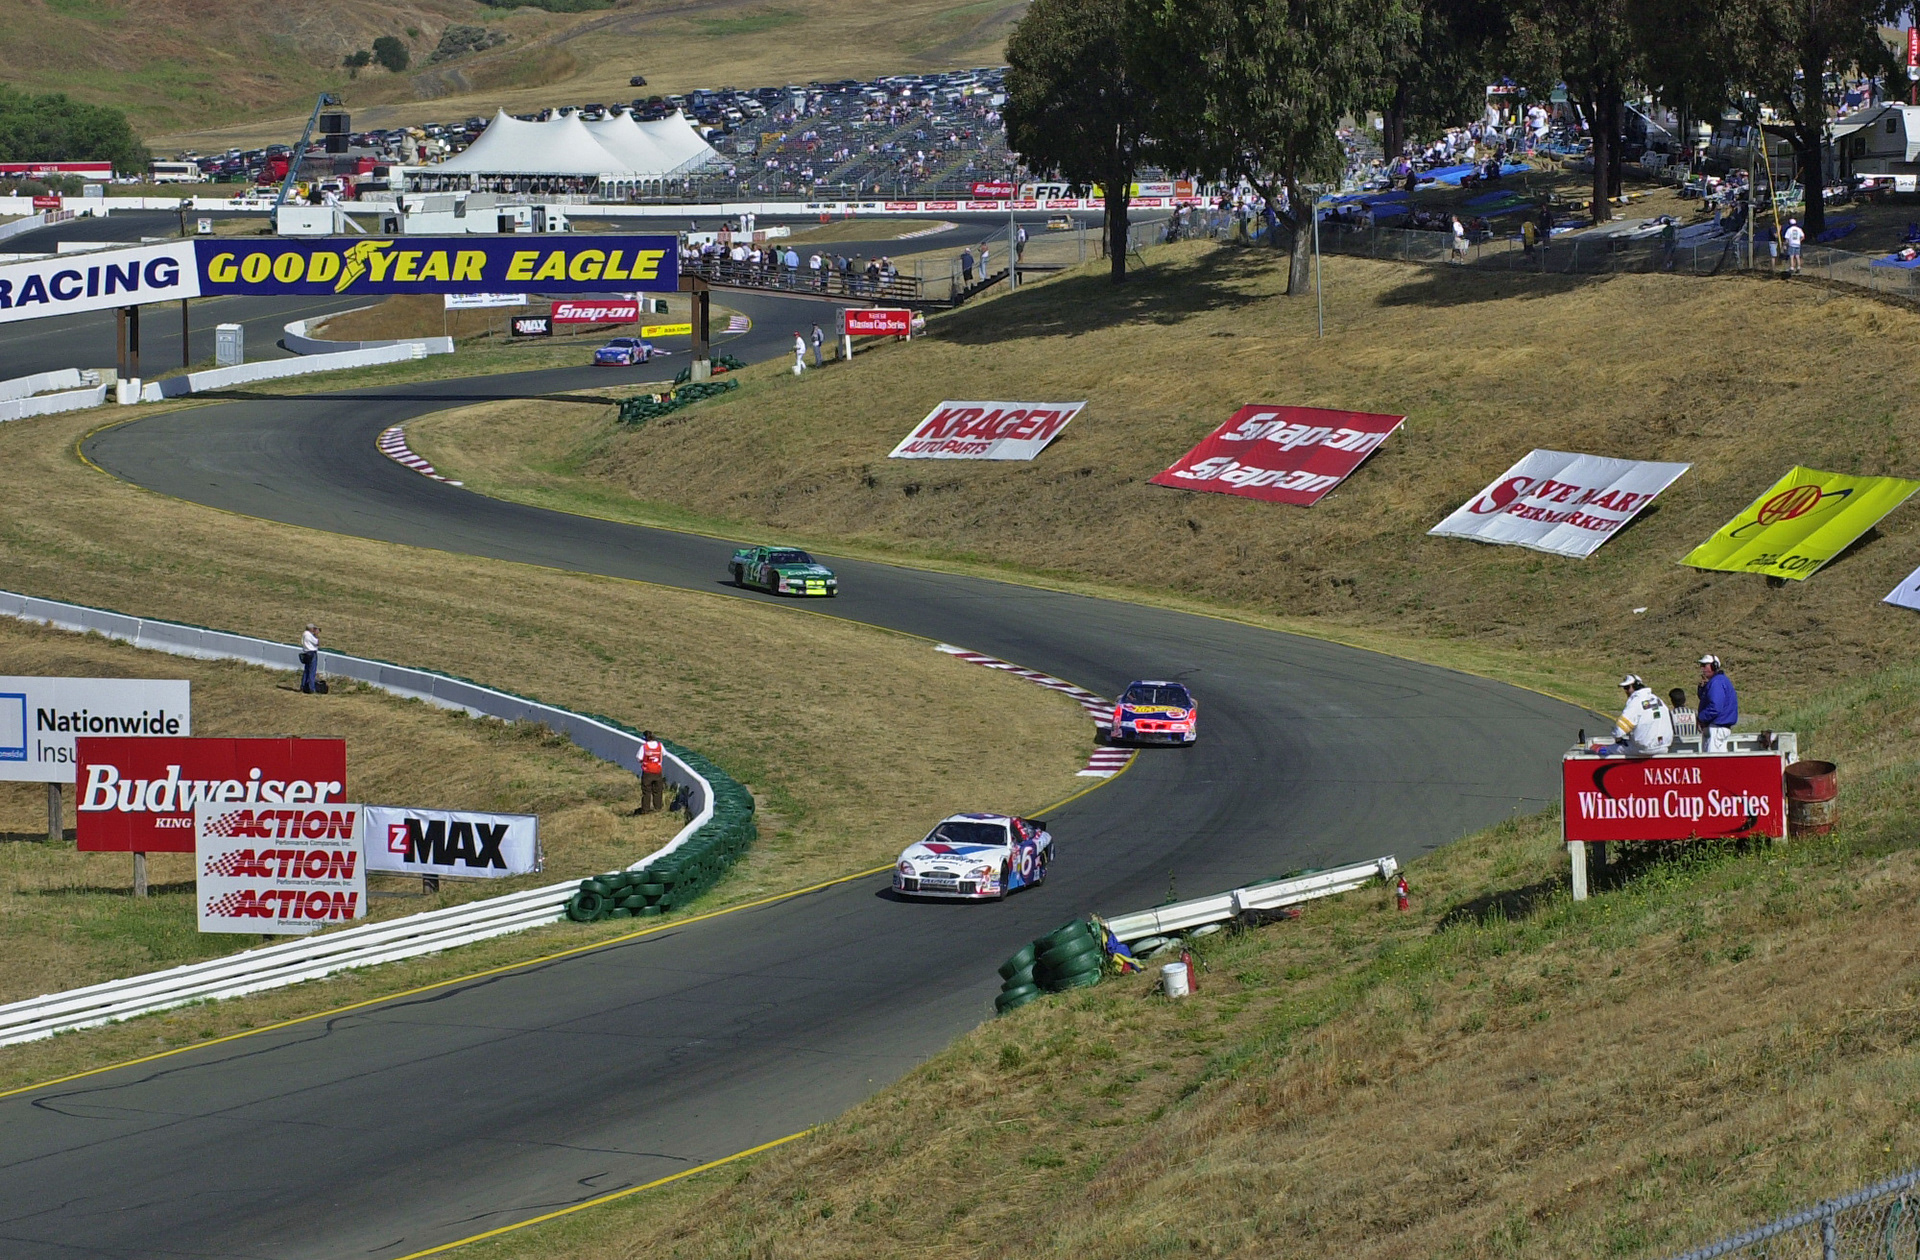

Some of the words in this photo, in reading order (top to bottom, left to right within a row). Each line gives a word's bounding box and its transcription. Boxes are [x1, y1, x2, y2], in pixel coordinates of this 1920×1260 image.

[974, 184, 1015, 196] Snap-on
[505, 250, 667, 281] EAGLE
[554, 304, 637, 321] Snap-on
[915, 407, 1077, 441] KRAGEN
[1219, 412, 1386, 453] Snap-on
[901, 440, 945, 453] AUTO
[943, 439, 992, 455] PARTS
[1171, 456, 1340, 492] Snap-on
[1571, 486, 1656, 513] MART
[37, 708, 180, 735] Nationwide
[78, 764, 343, 812] Budweiser
[1643, 767, 1703, 785] NASCAR
[1578, 791, 1660, 820] Winston
[1663, 789, 1704, 821] Cup
[1707, 788, 1770, 818] Series
[155, 818, 192, 828] KING
[226, 809, 356, 839] ACTION
[227, 849, 357, 879] ACTION
[1021, 846, 1034, 876] 6
[228, 889, 358, 920] ACTION
